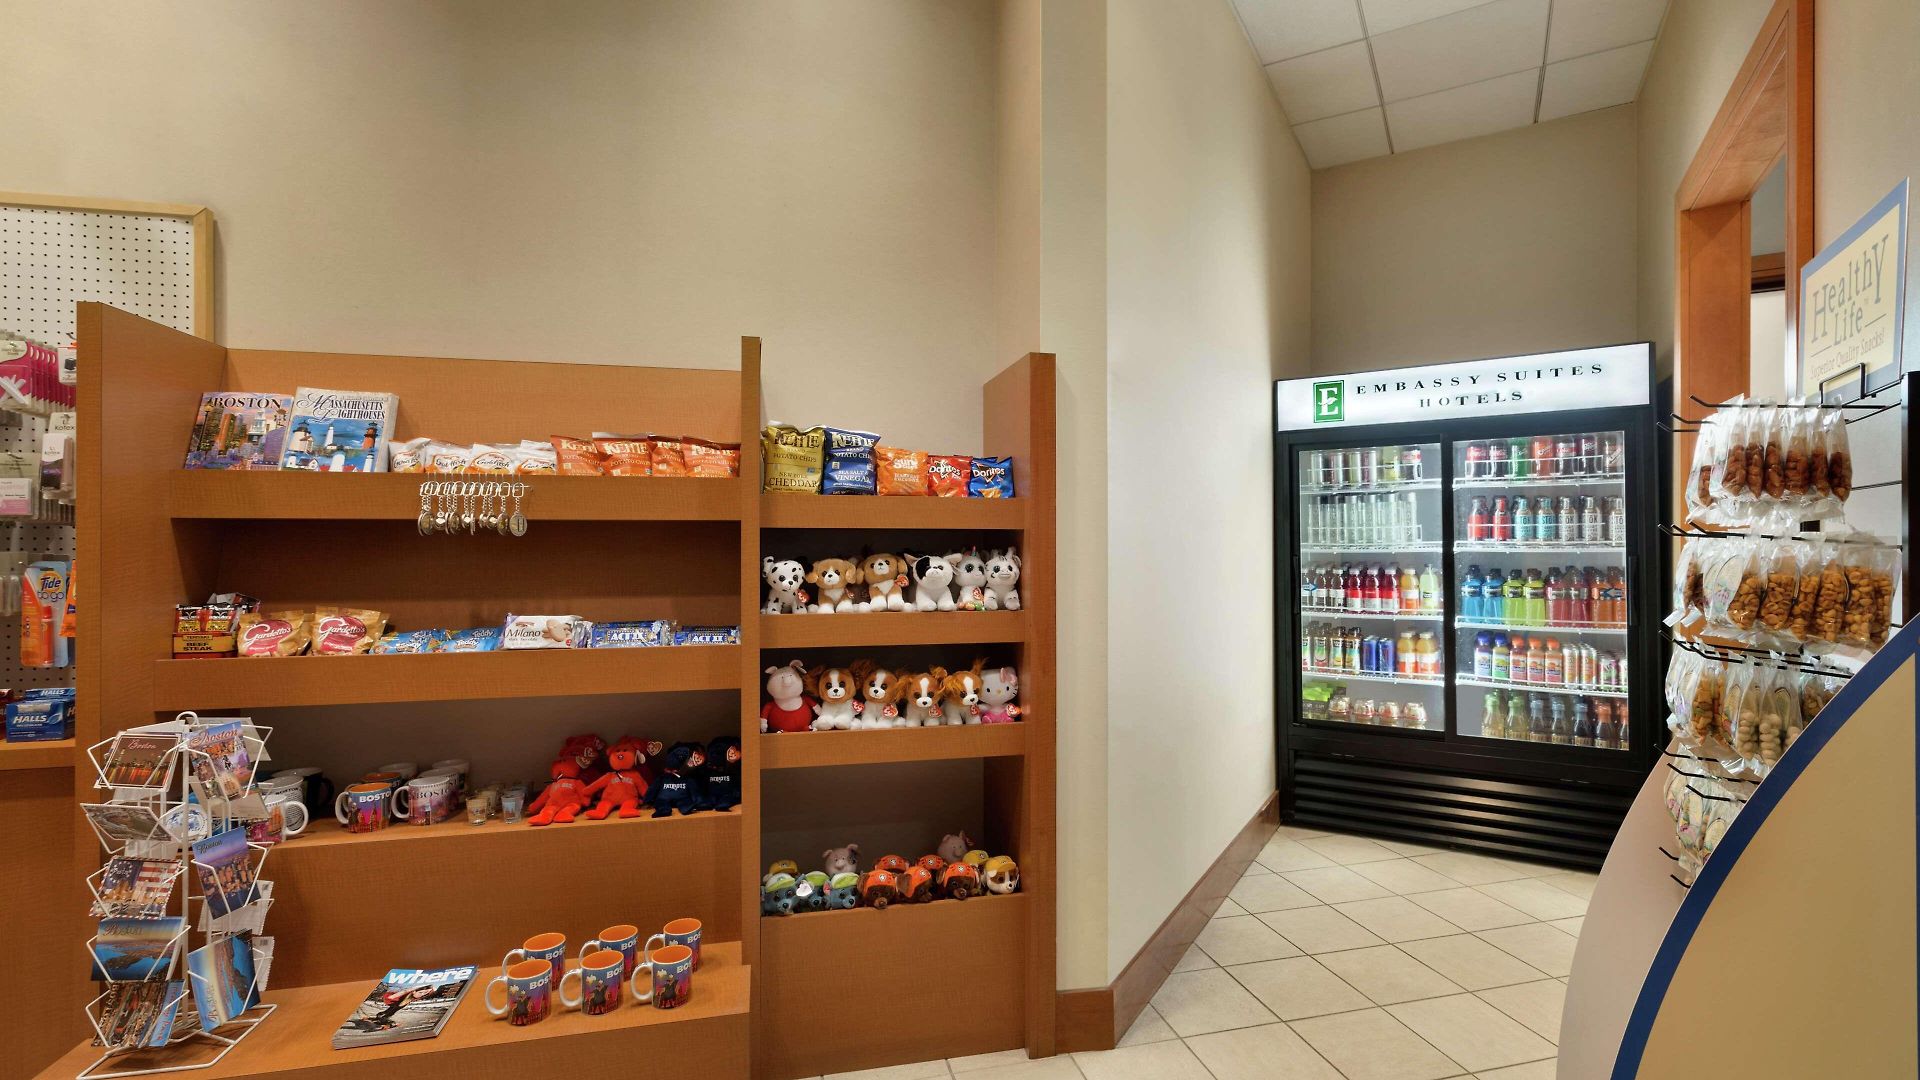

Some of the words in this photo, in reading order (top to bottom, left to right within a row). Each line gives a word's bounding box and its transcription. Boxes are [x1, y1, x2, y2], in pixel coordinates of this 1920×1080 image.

[1834, 301, 1863, 345] Life
[1356, 374, 1482, 395] EMBASSY
[1496, 363, 1604, 383] SUITES
[210, 397, 282, 410] BOSTON
[1419, 390, 1524, 408] HOTELS
[972, 466, 1005, 478] Doritos
[768, 477, 819, 489] CHEDDAR
[835, 475, 872, 484] VINEGAR
[41, 577, 62, 591] Tide
[50, 592, 64, 602] go
[505, 628, 541, 638] Milano
[692, 634, 711, 643] ACT
[13, 715, 48, 724] HALLS
[710, 776, 730, 784] PATRIOTS
[388, 967, 474, 984] where
